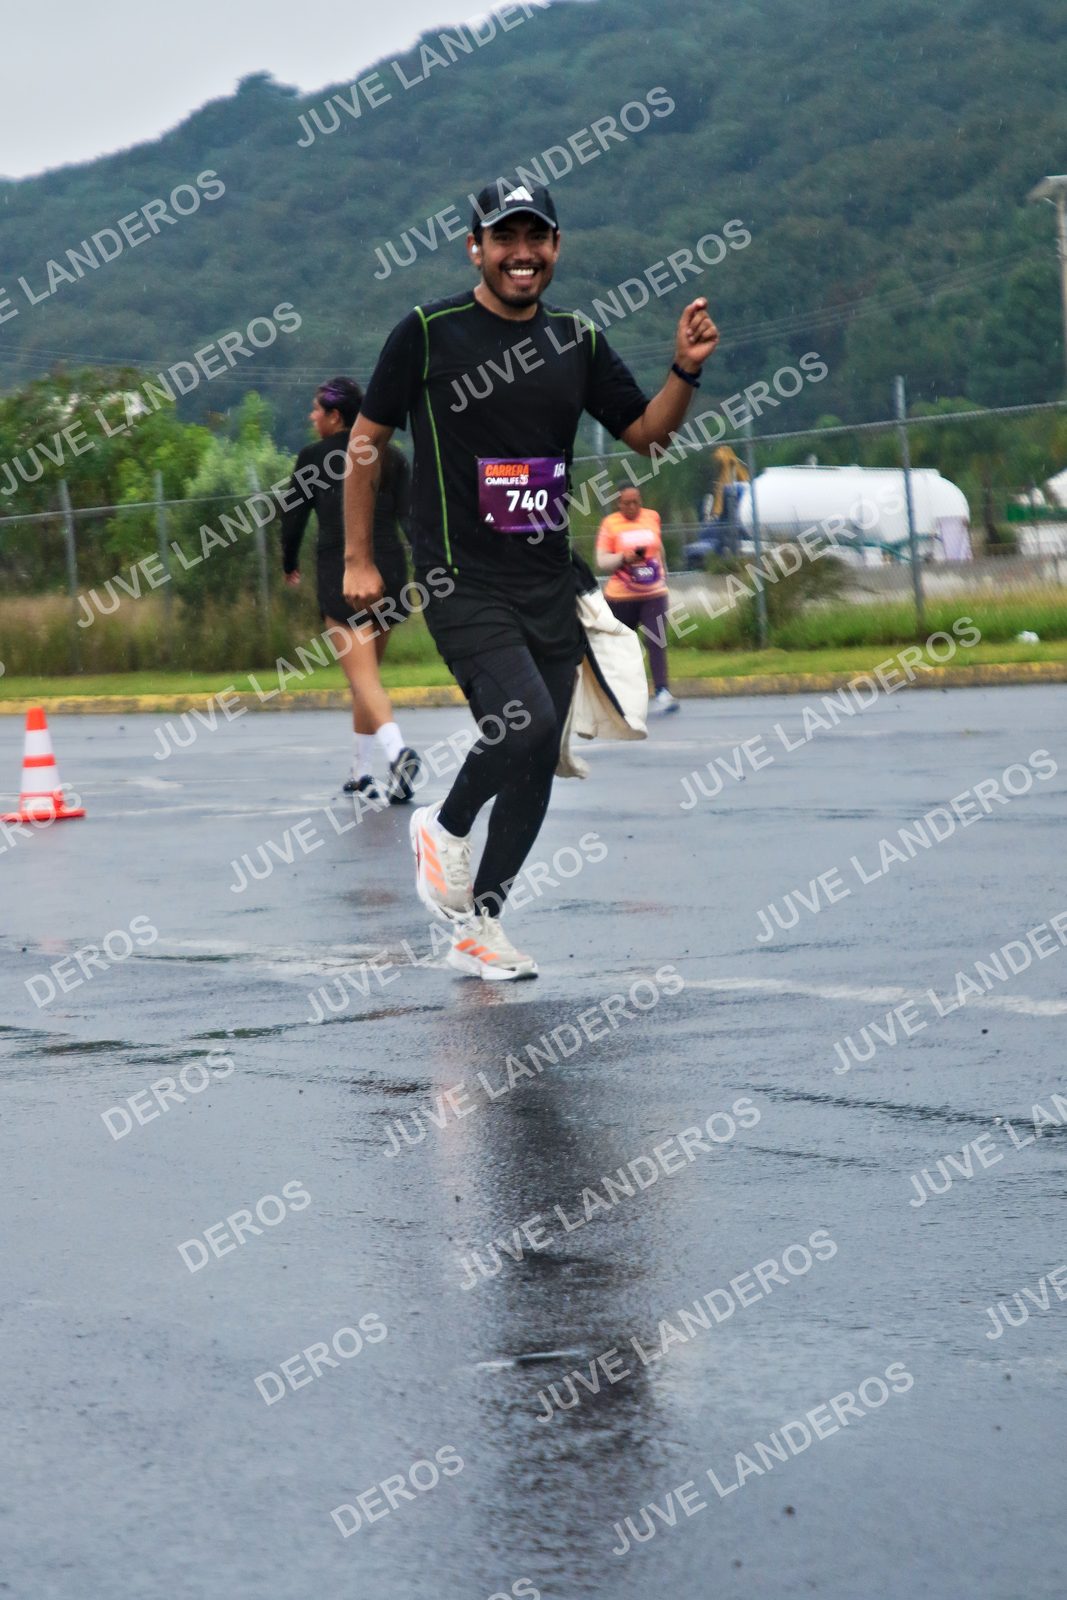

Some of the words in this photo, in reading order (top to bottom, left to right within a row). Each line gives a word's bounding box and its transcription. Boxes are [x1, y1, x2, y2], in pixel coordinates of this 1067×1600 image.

[485, 464, 529, 476] CARRERA
[485, 477, 520, 485] OMNILIFE
[506, 490, 548, 511] 740
